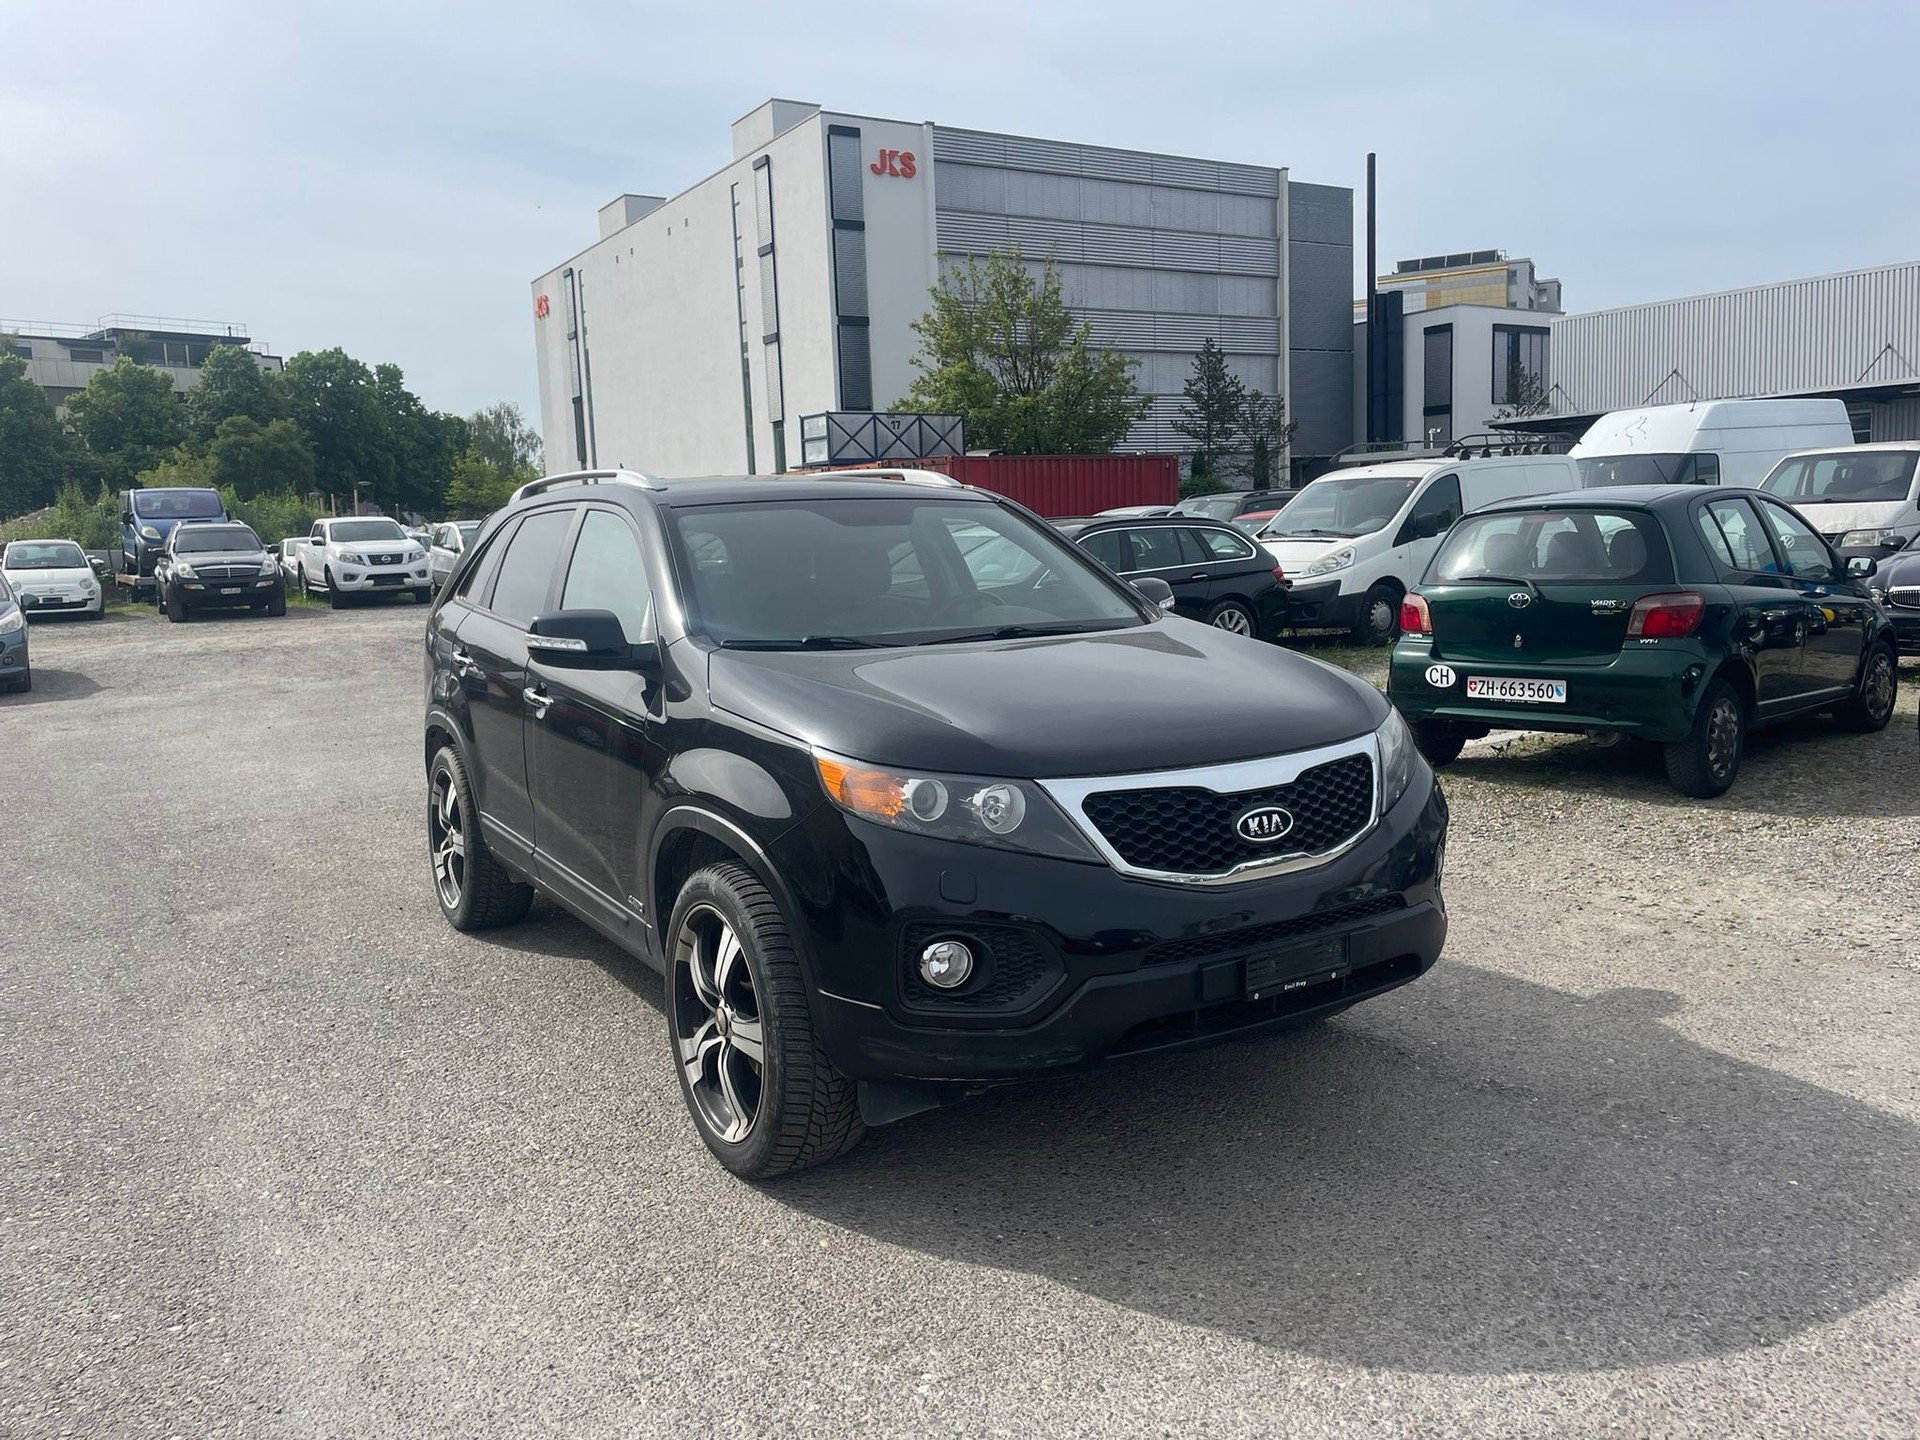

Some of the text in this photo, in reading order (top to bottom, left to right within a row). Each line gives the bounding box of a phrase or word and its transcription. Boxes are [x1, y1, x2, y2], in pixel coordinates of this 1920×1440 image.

[870, 148, 916, 178] JKS
[891, 420, 900, 430] 17
[1591, 600, 1617, 608] YARIS
[1430, 667, 1450, 685] CH
[1247, 814, 1284, 836] KIA
